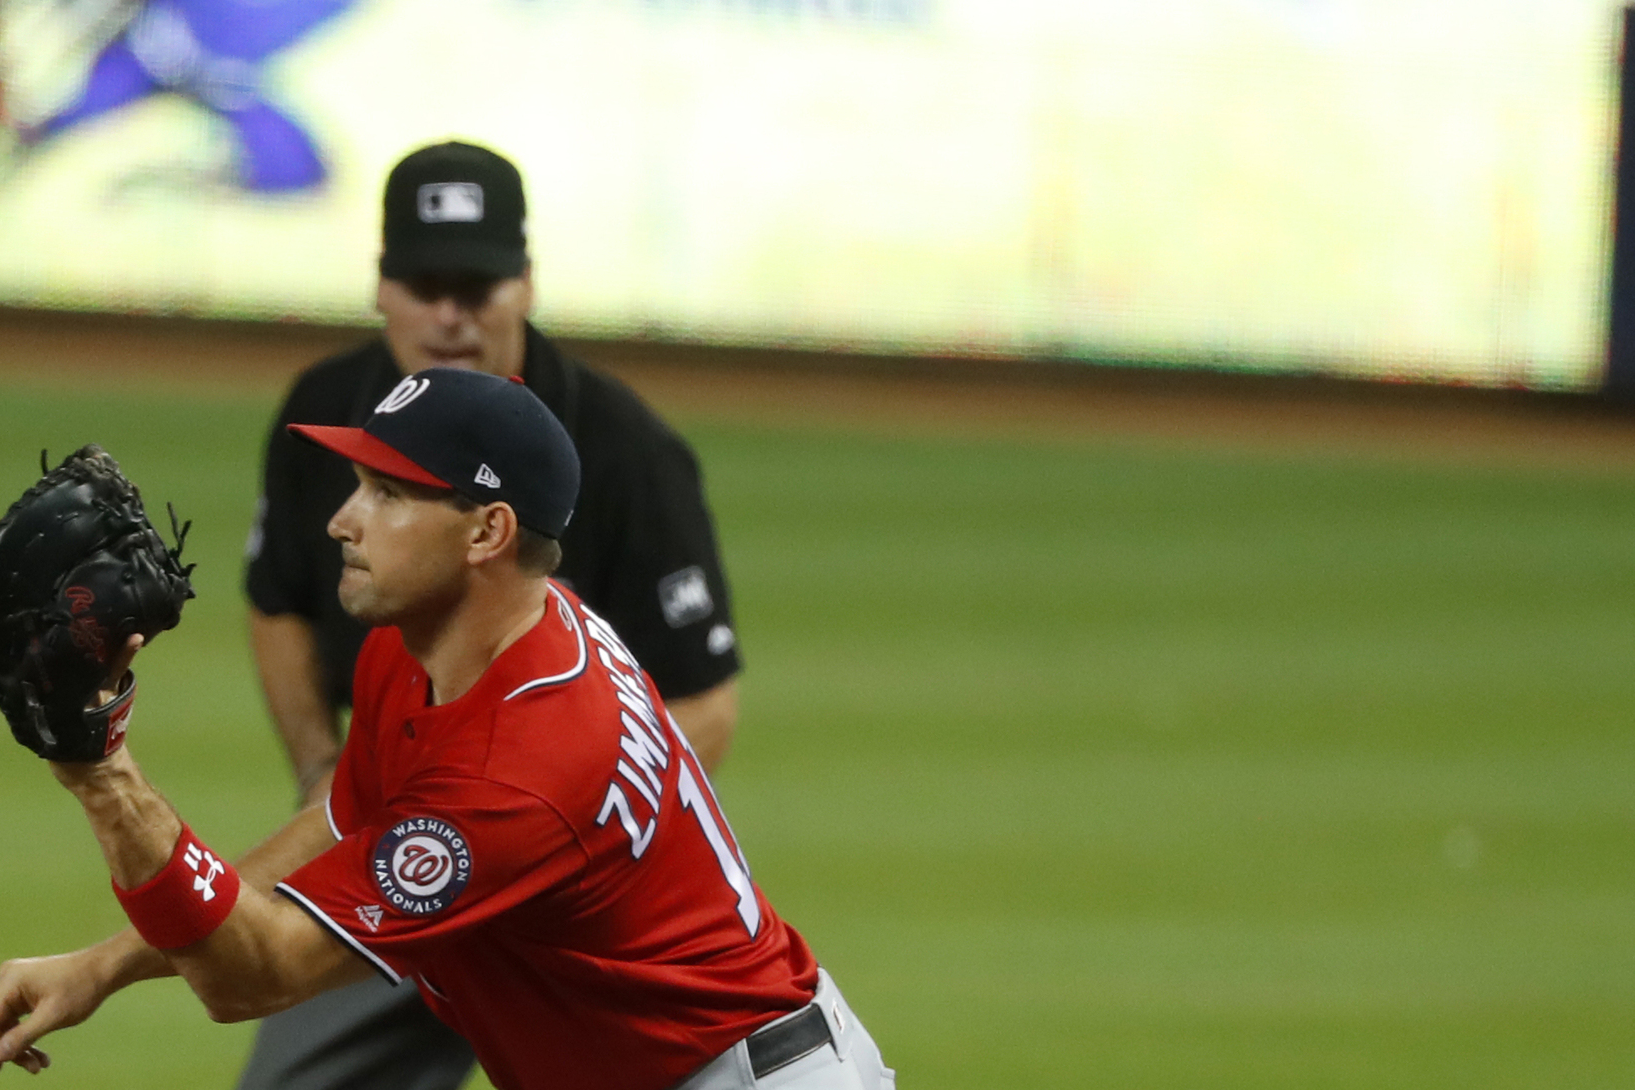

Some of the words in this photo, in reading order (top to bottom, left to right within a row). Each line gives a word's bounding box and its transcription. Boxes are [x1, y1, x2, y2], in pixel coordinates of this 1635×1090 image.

[391, 818, 470, 882] WASHINGTON
[398, 844, 450, 887] W
[375, 858, 443, 914] NATIONALS
